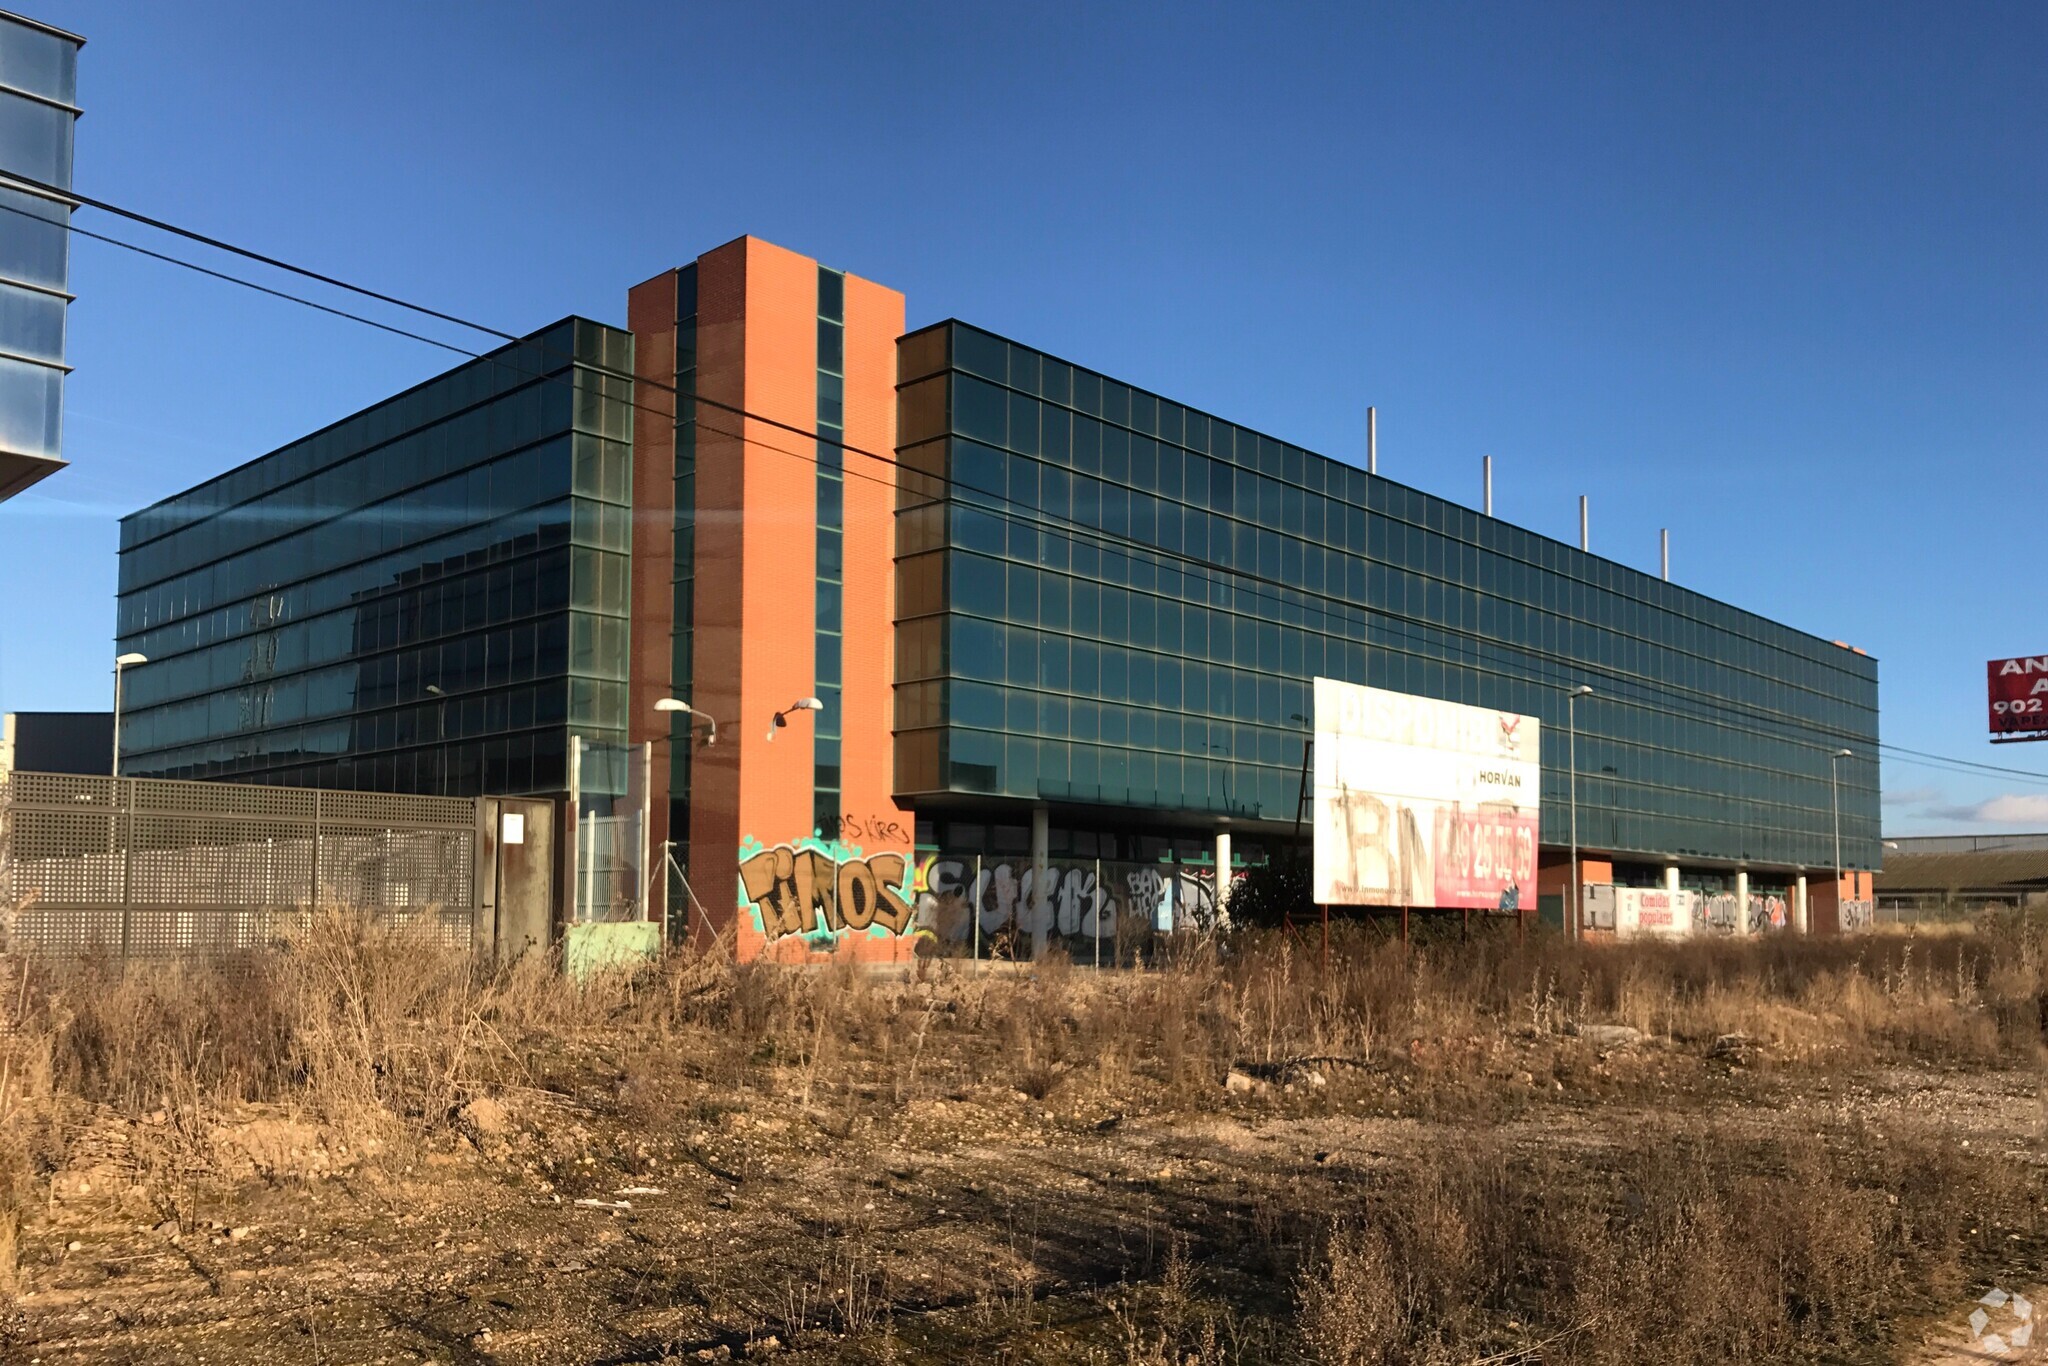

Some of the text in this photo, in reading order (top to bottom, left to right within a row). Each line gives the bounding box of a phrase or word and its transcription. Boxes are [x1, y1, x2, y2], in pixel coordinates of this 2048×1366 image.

[1993, 698, 2043, 714] 902
[1479, 768, 1522, 788] HORVAN
[1640, 891, 1671, 908] Comidas
[1639, 909, 1674, 925] populares
